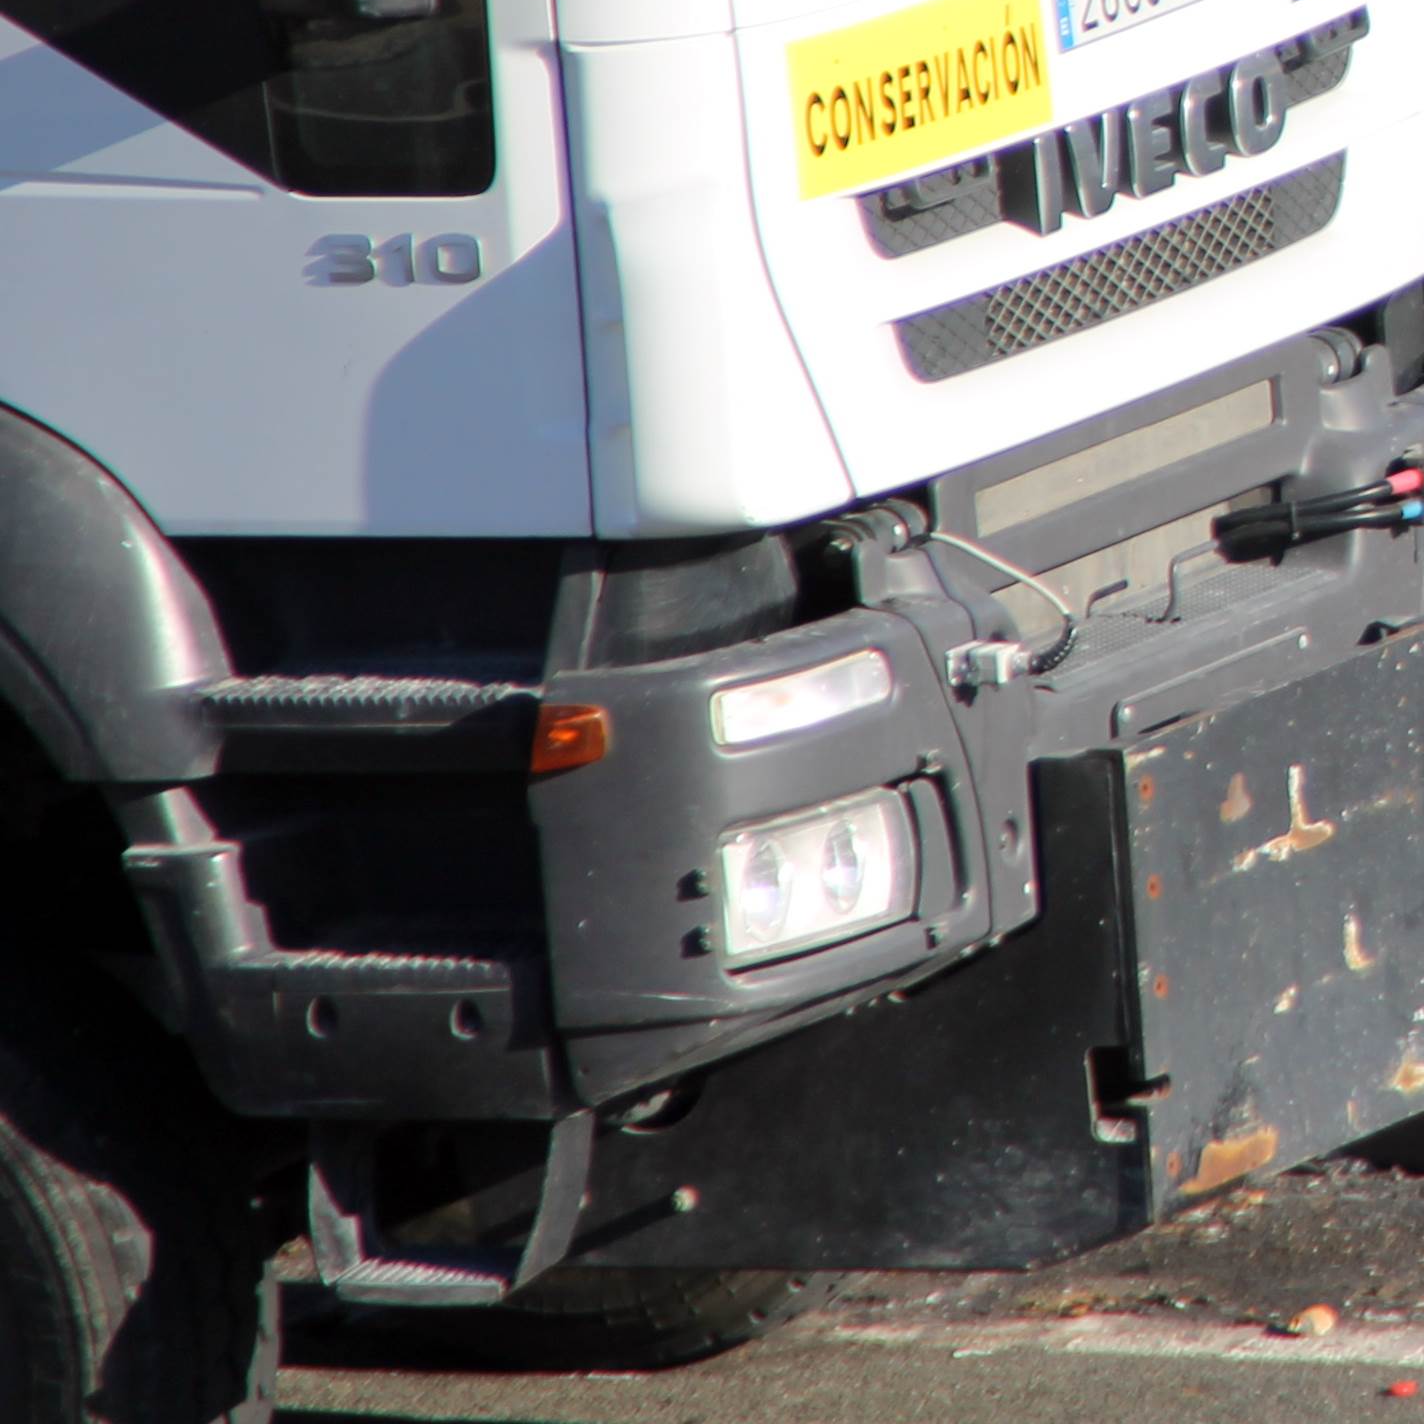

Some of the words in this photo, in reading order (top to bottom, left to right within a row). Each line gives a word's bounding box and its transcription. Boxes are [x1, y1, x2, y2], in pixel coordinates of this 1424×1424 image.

[804, 2, 1041, 158] CONSERVACIÓN
[1030, 50, 1288, 237] IVECO
[302, 232, 482, 288] 310
